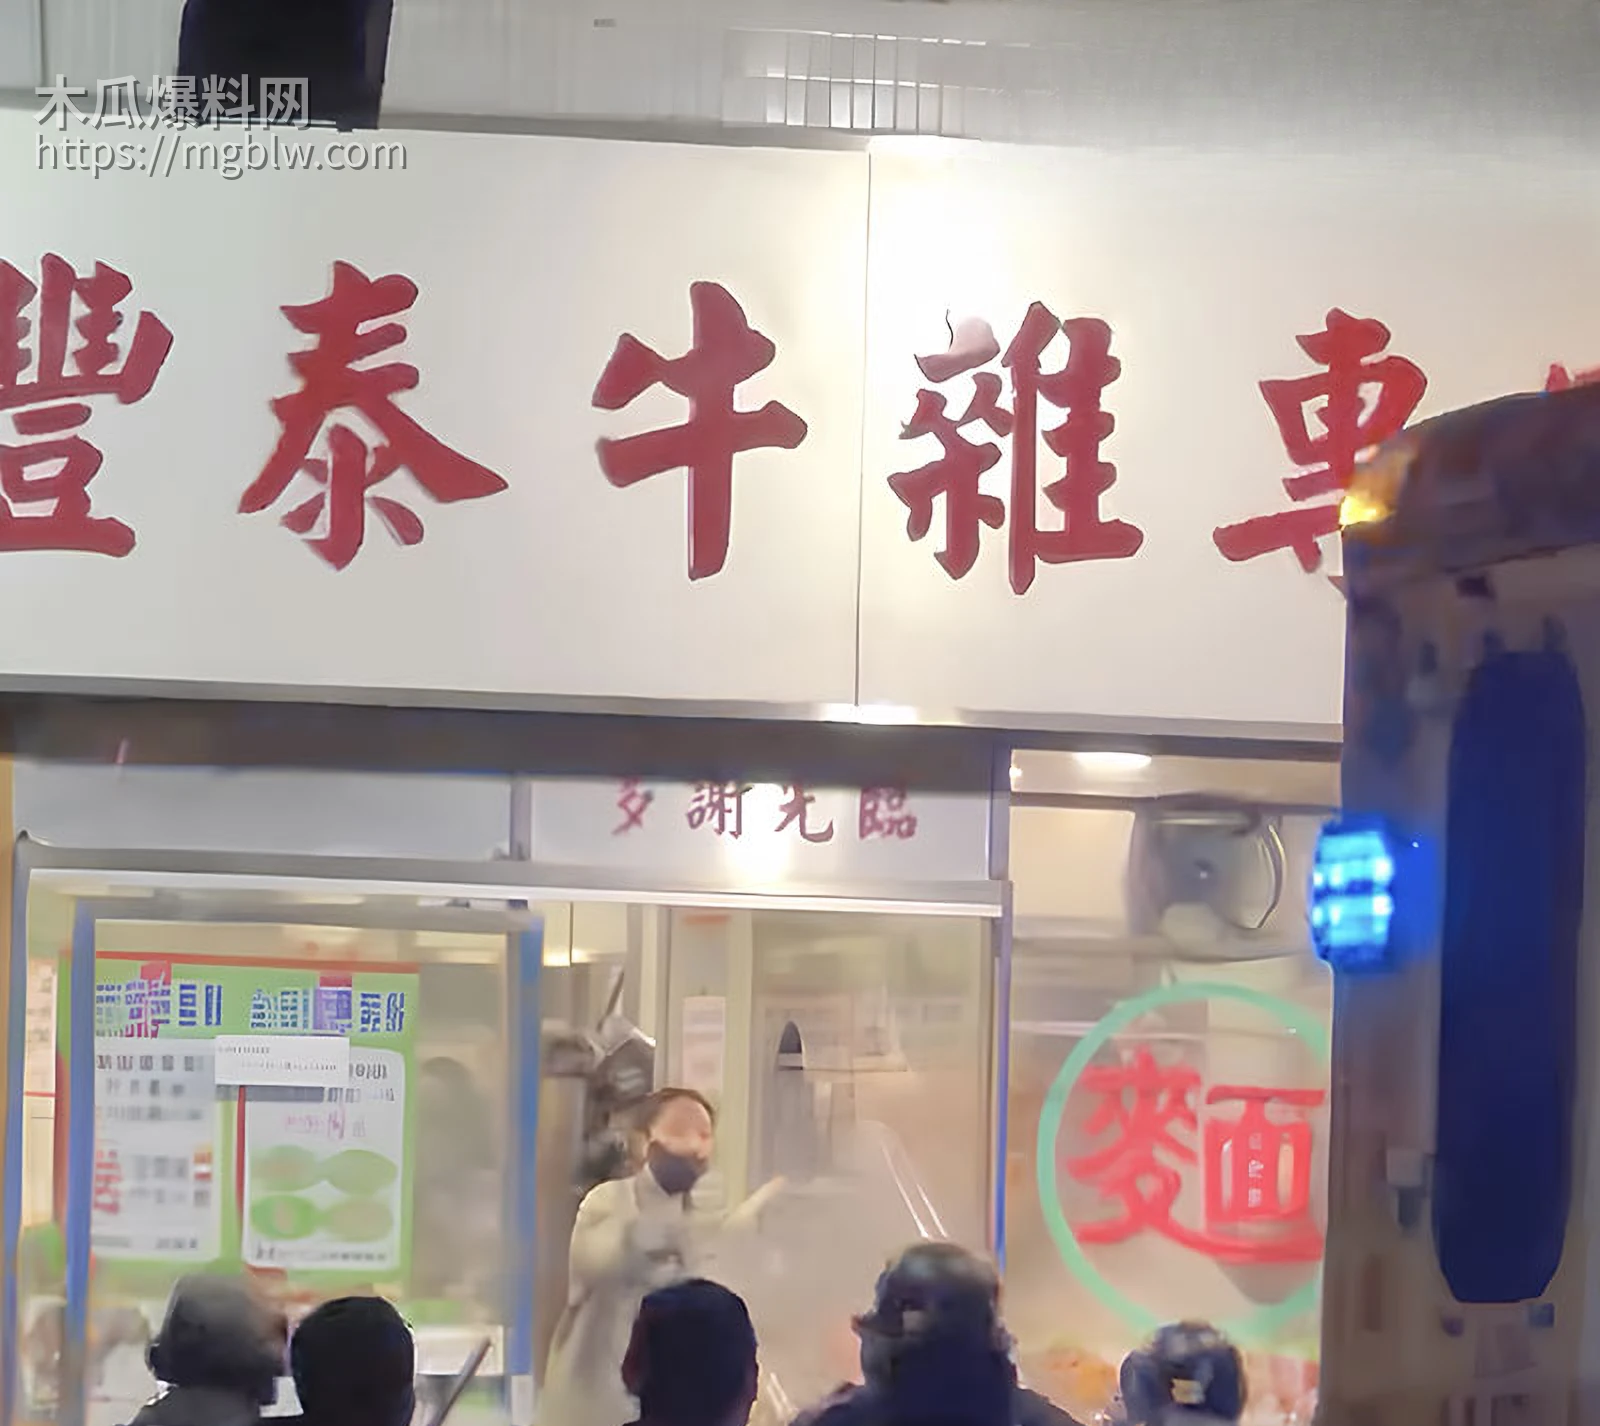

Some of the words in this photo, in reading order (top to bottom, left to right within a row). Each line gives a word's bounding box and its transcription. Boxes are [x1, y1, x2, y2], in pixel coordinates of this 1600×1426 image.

[0, 252, 1600, 596] 豐泰牛雜專
